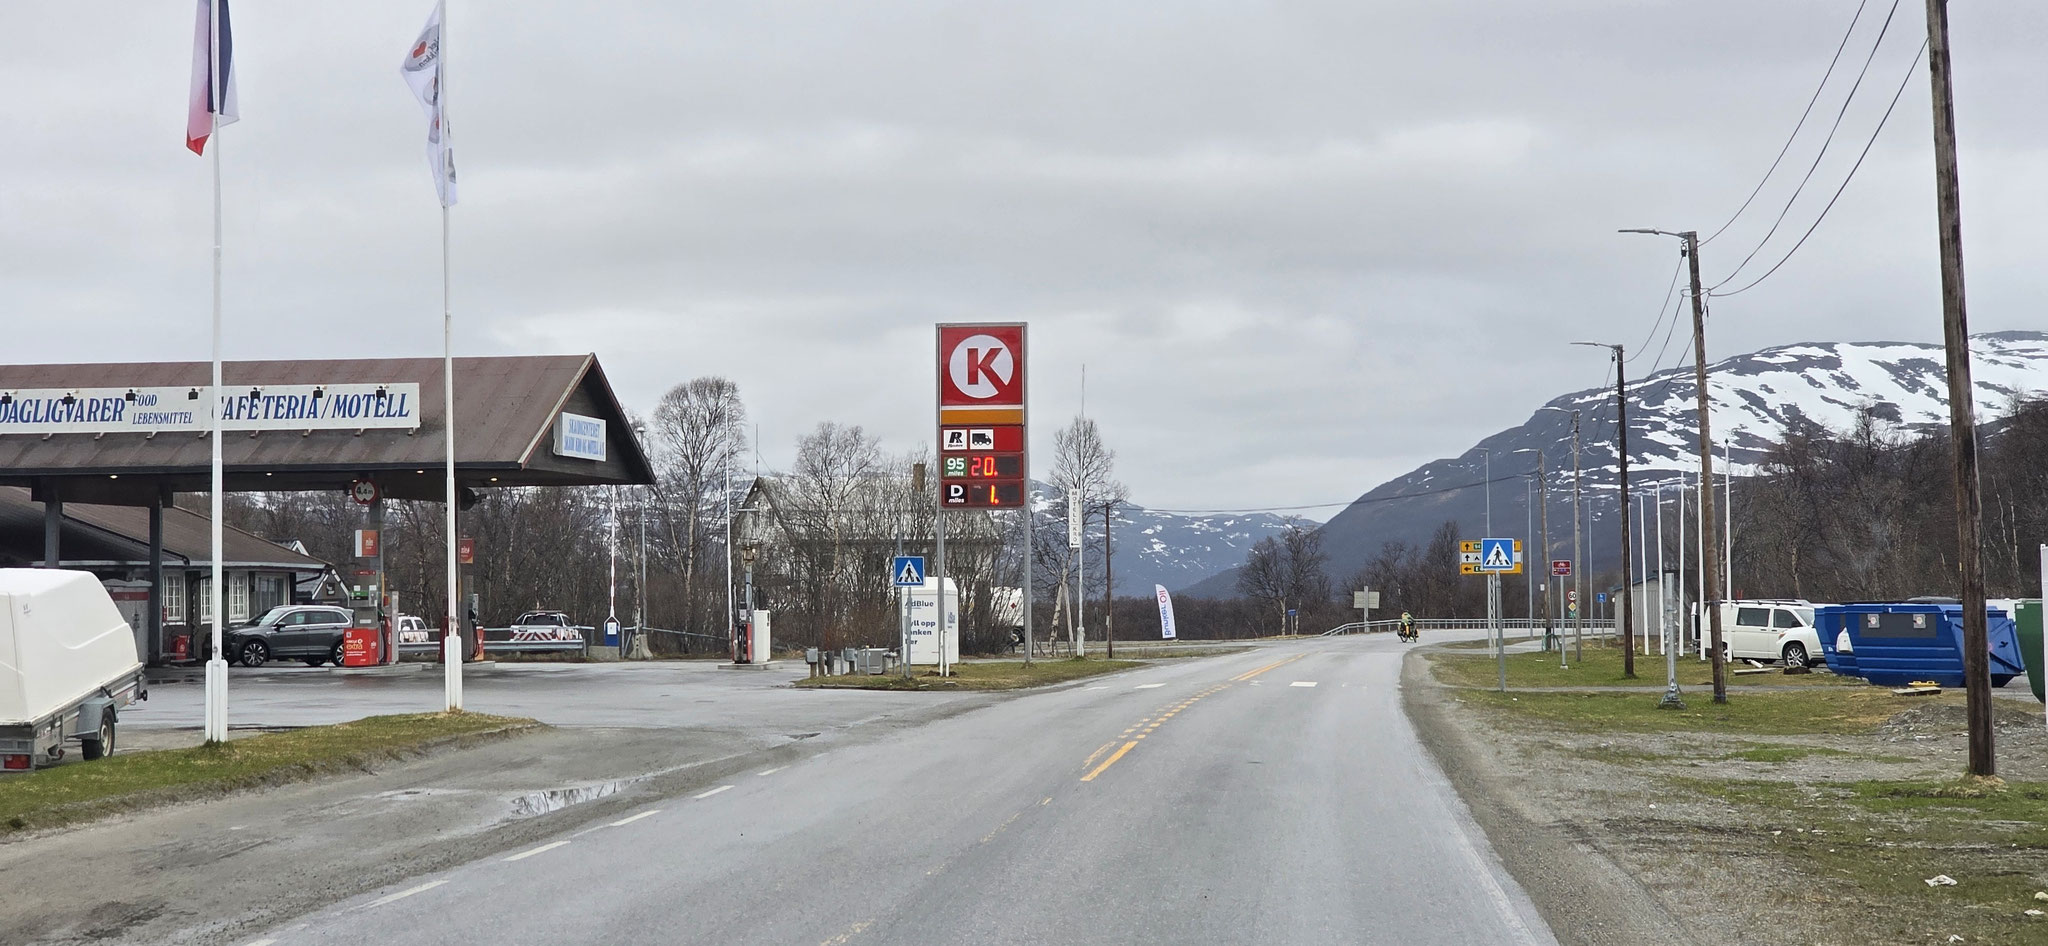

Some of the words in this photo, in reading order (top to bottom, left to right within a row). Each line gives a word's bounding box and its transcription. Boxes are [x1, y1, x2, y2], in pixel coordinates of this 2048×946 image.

[967, 347, 1007, 394] K
[132, 394, 157, 407] FOOD
[211, 393, 410, 420] AFETERIA/MOTELL
[0, 398, 125, 423] DAGLIGVARER
[132, 411, 193, 425] LEBENSMITTEL
[947, 457, 965, 470] 95
[950, 484, 964, 497] D
